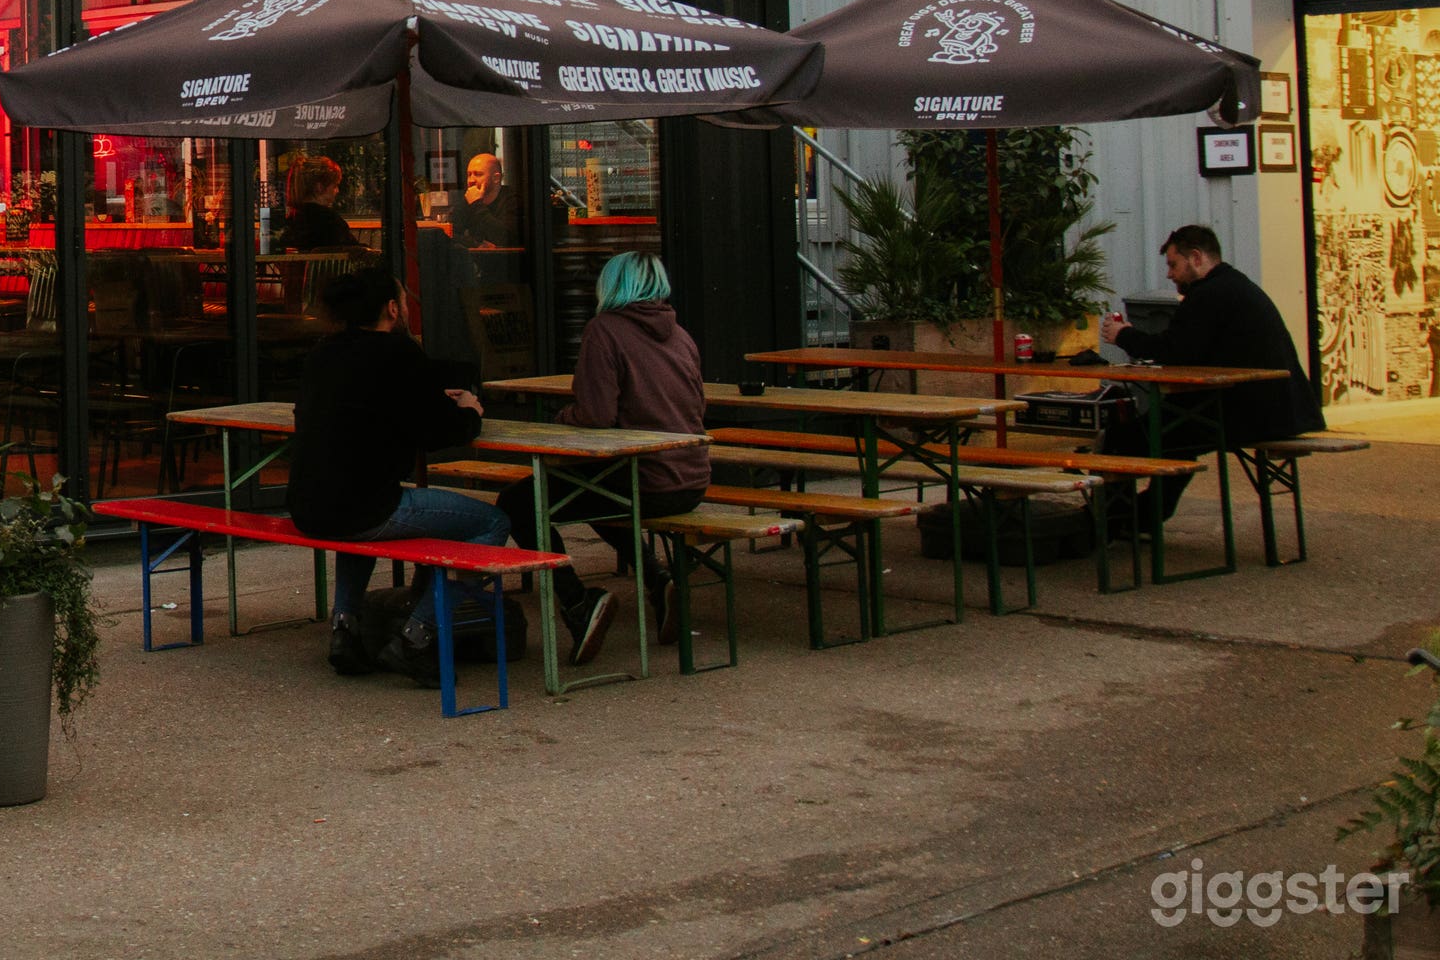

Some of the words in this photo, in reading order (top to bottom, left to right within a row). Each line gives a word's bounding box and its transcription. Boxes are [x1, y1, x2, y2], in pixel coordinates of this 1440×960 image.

[1004, 0, 1035, 21] GREAT
[443, 11, 517, 38] BREW
[524, 32, 549, 45] MUSIC
[898, 21, 916, 47] GREAT
[1019, 22, 1036, 44] BEER
[180, 73, 252, 99] SIGNATURE
[558, 65, 606, 92] GREAT
[602, 67, 646, 93] BEER
[642, 68, 658, 93] &
[656, 68, 705, 93] GREAT
[705, 66, 761, 91] MUSIC
[195, 95, 229, 107] BREW
[913, 95, 1004, 112] SIGNATURE
[936, 112, 979, 121] BREW
